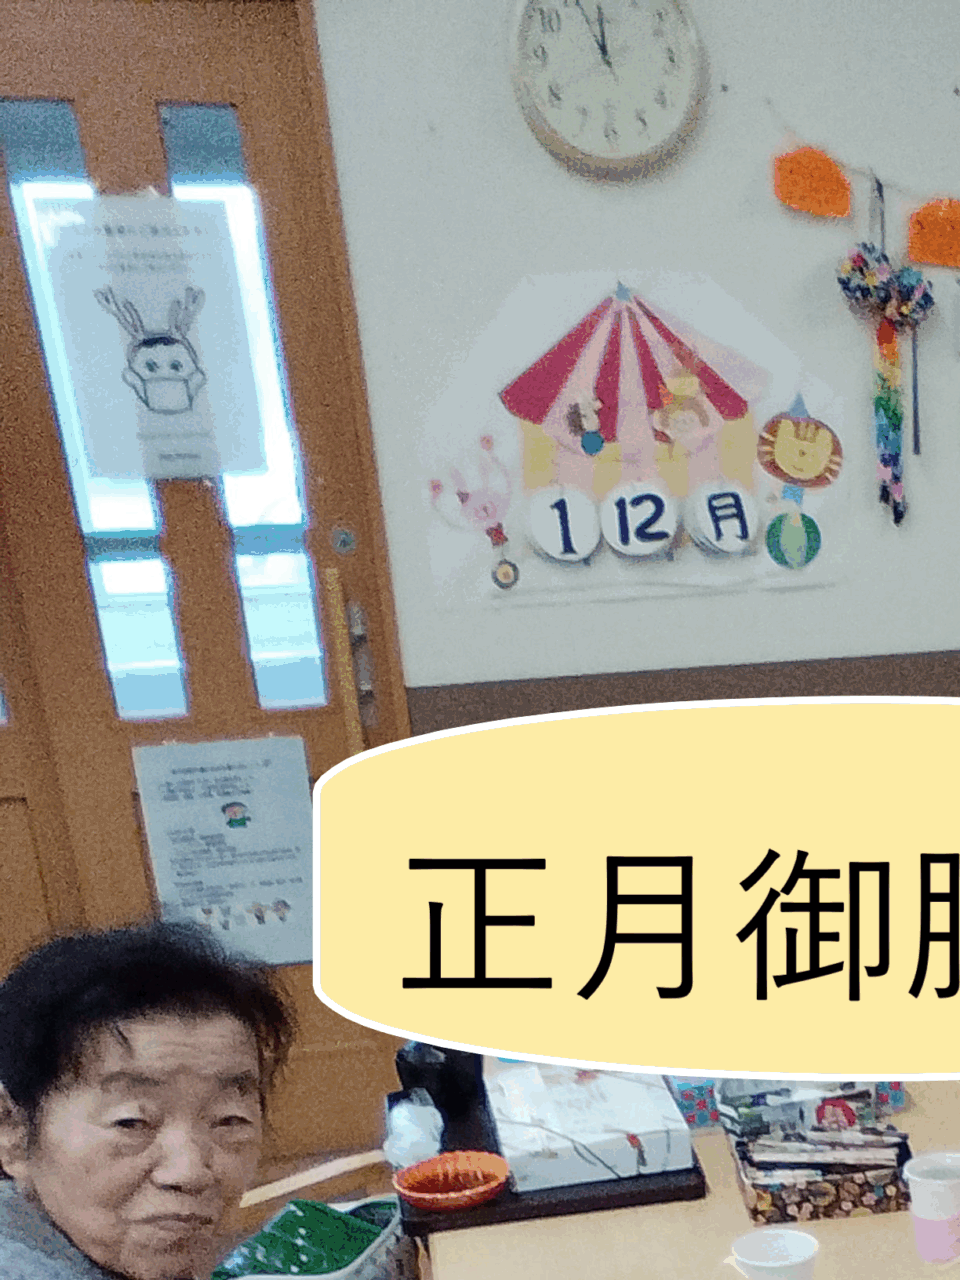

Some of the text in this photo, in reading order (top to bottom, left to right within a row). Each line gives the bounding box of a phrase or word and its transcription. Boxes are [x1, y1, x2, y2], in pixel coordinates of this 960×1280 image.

[538, 6, 562, 34] 10
[532, 43, 548, 68] 9
[550, 491, 750, 555] 1 12 月
